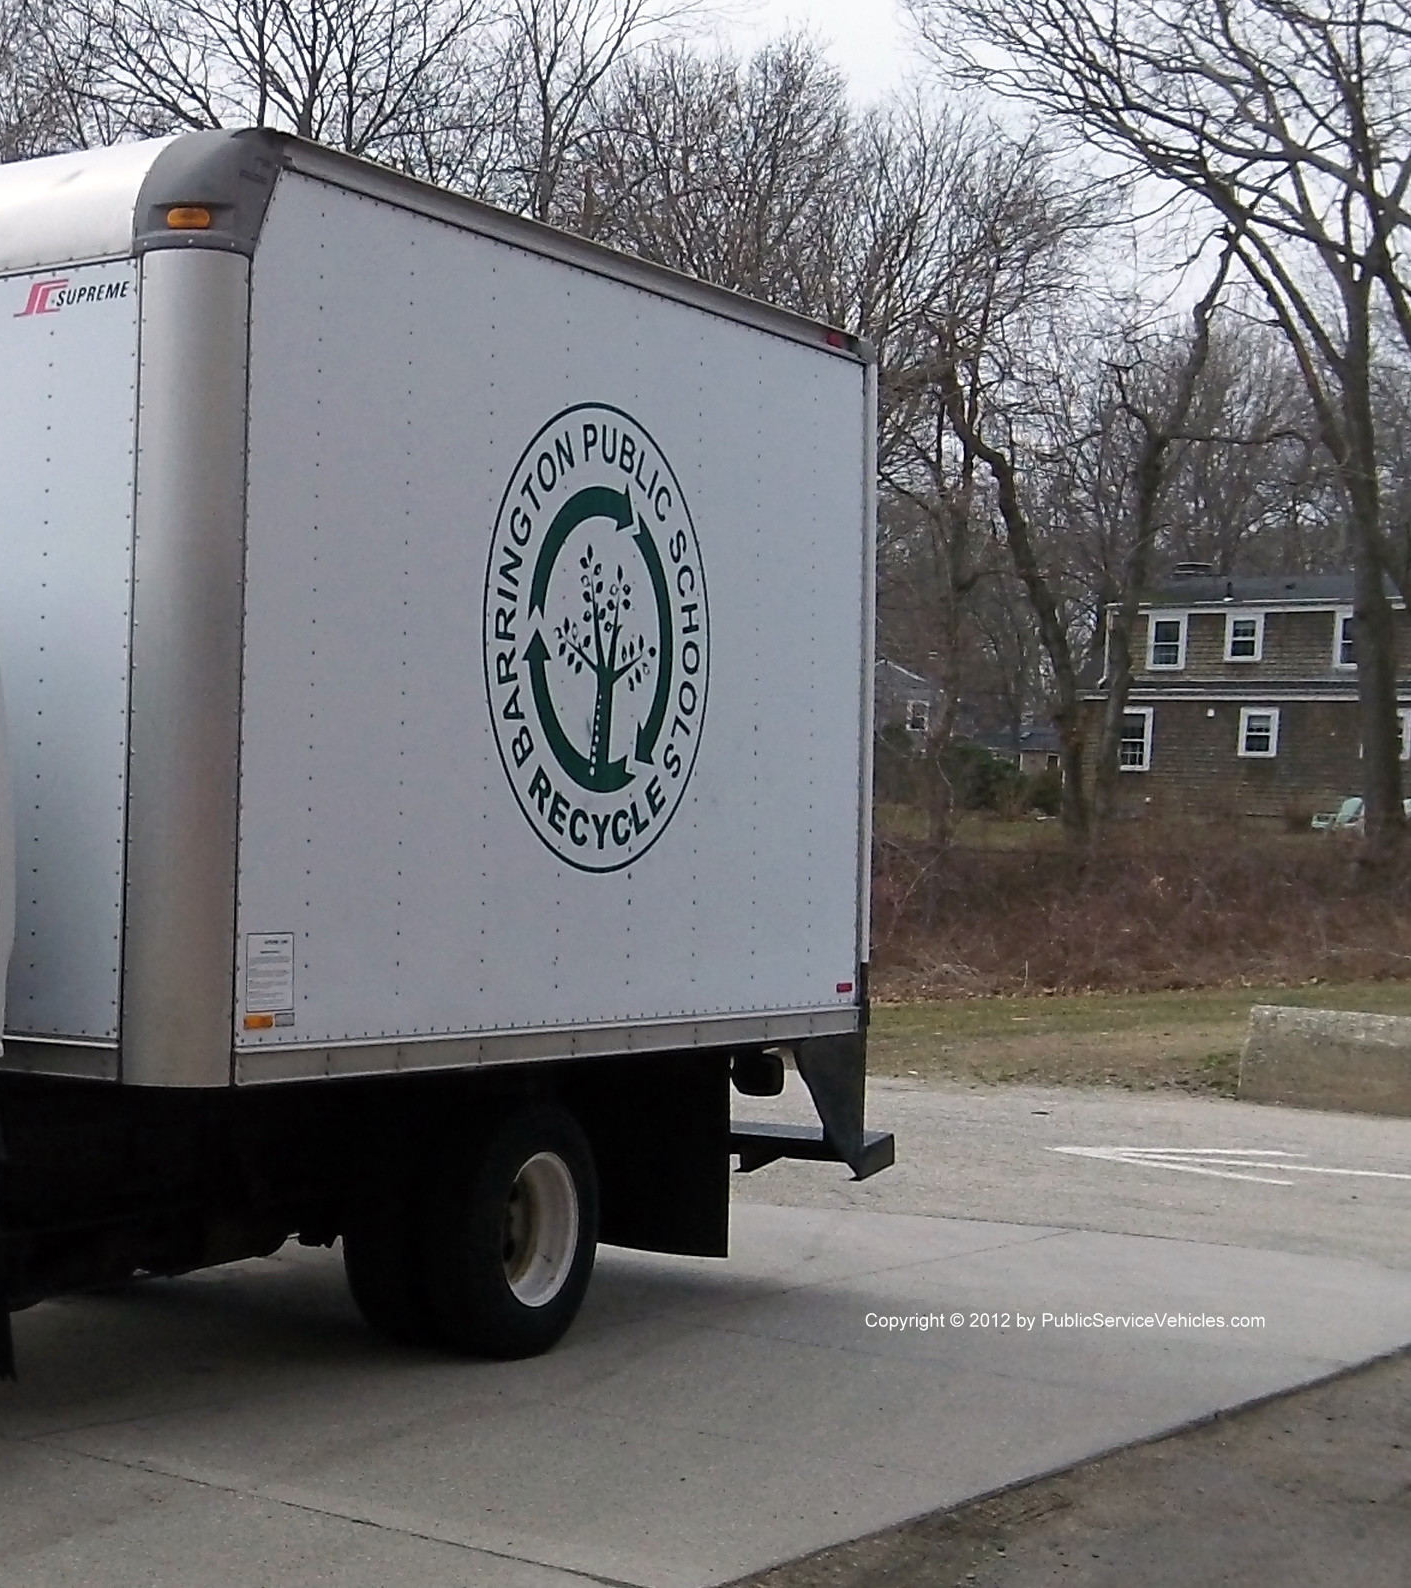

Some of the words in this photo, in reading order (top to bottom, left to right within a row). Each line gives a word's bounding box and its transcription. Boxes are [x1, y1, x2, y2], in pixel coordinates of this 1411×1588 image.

[56, 281, 130, 307] SUPREME
[495, 431, 575, 769] BARRINGTON
[583, 424, 672, 522] PUBLIC
[663, 530, 701, 779] SCHOOLS
[528, 765, 667, 850] RECYCLE
